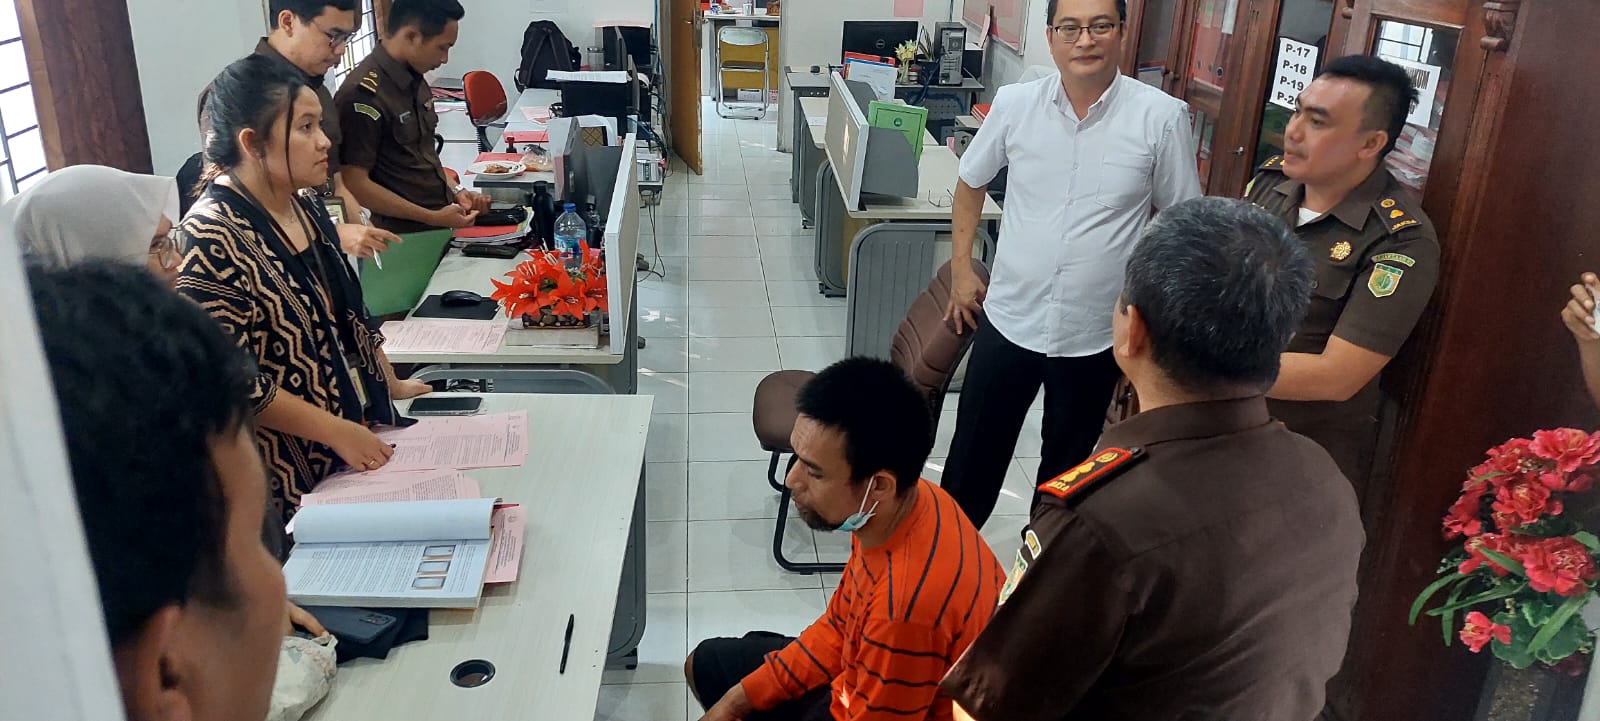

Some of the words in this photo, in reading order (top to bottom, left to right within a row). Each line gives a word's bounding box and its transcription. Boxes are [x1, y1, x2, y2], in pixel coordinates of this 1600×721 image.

[1285, 43, 1311, 58] P-17
[1282, 60, 1307, 75] P-18
[1280, 76, 1304, 91] P-19
[1277, 91, 1296, 105] P-2
